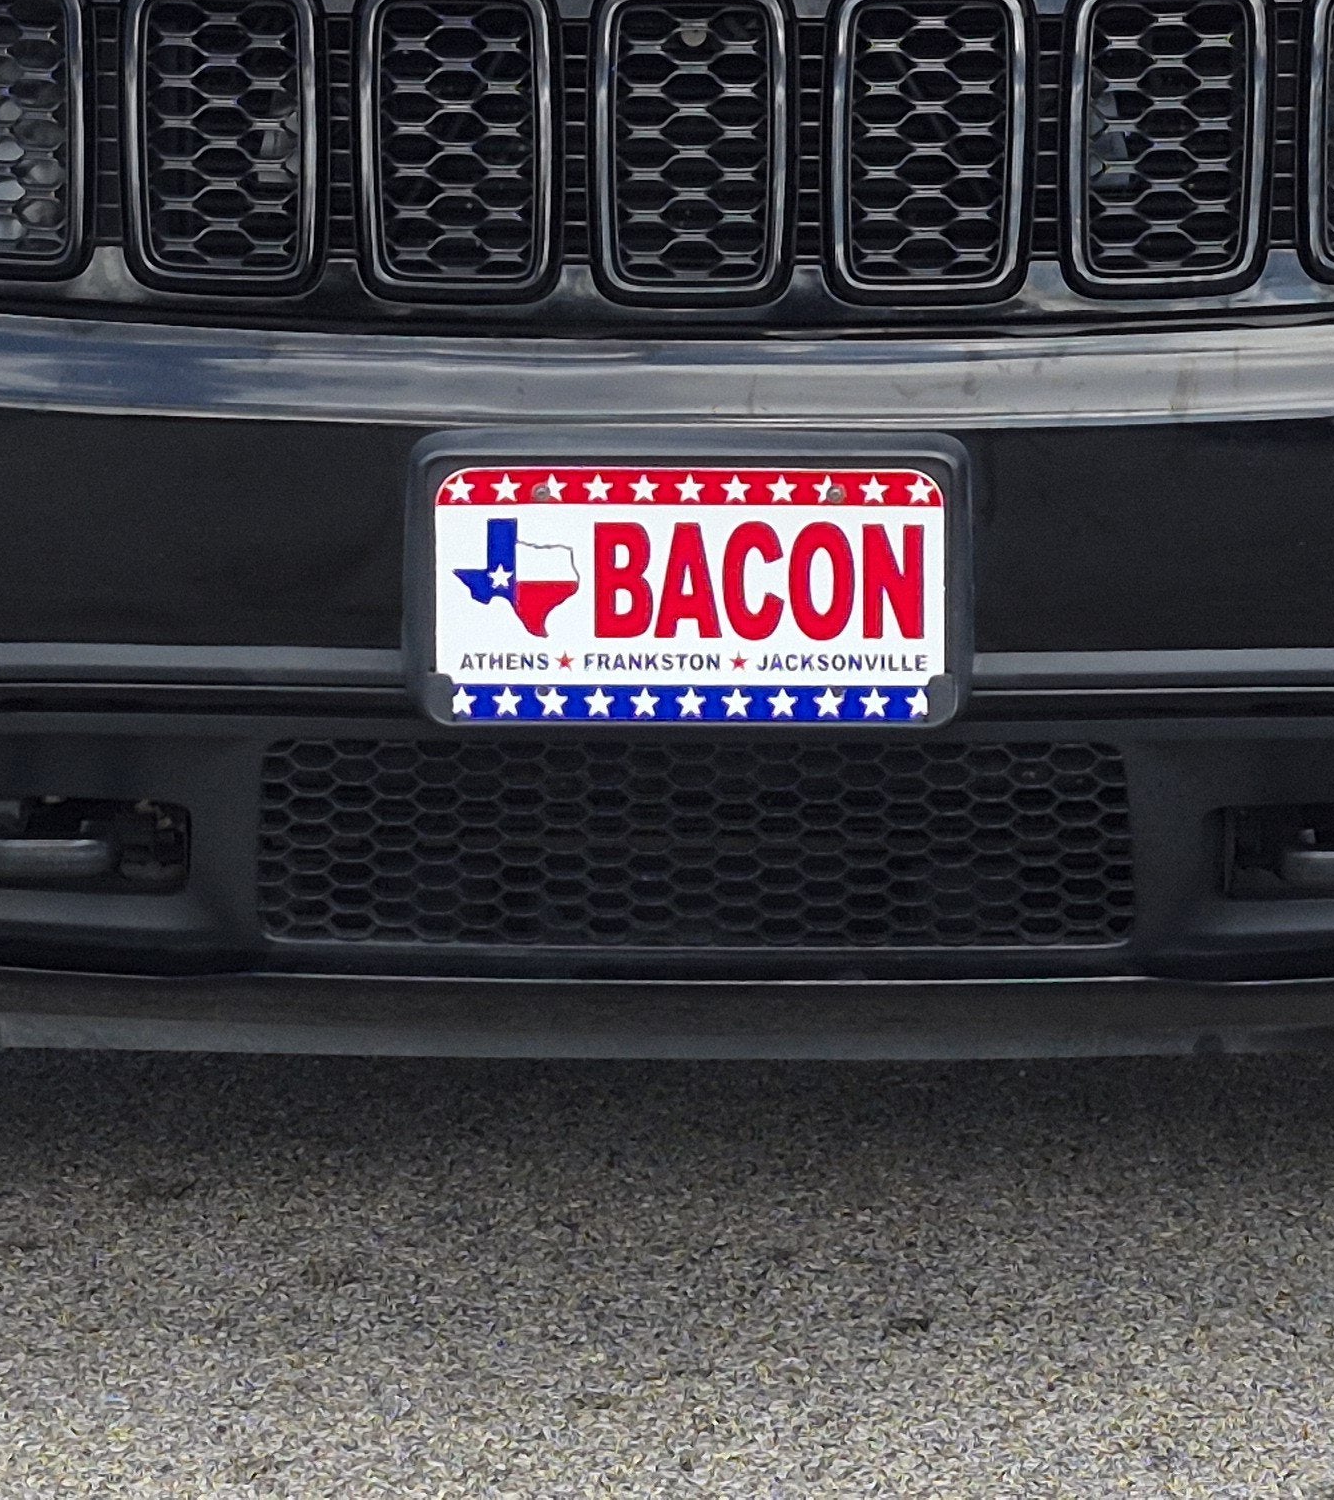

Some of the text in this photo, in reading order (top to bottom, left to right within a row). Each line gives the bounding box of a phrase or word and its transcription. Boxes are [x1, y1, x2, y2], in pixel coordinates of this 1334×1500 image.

[593, 521, 925, 640] BACON
[460, 652, 928, 672] ATHENS FRANKSTON JACKSONVILLE
